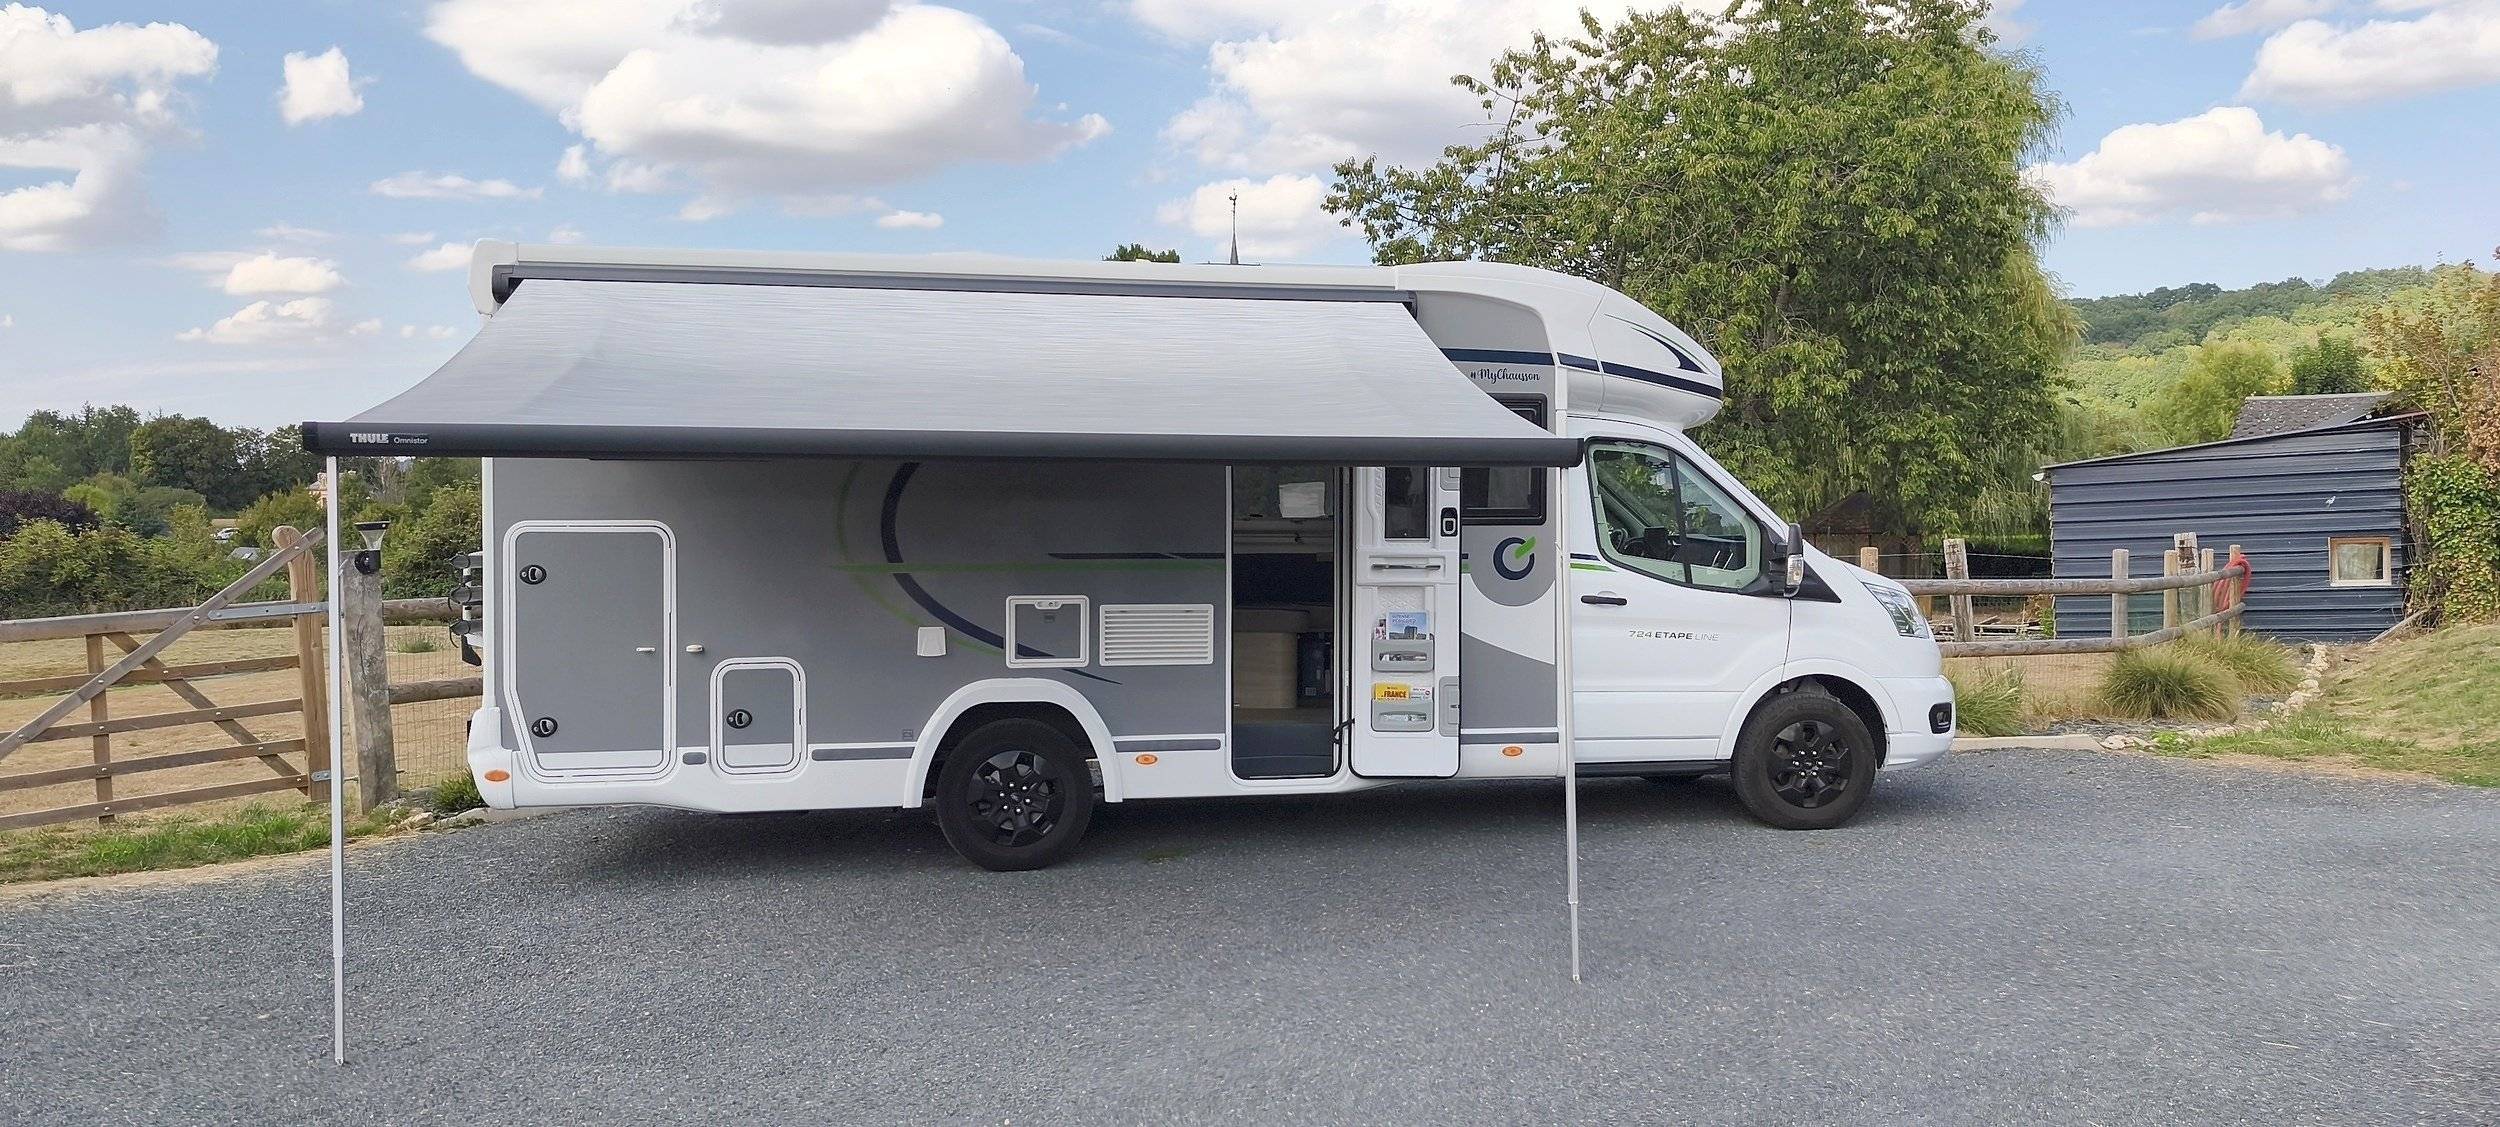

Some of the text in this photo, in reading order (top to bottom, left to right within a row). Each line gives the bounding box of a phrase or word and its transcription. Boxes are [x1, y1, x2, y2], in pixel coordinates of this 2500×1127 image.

[349, 433, 389, 443] THULE
[1654, 632, 1693, 640] ETAPE
[1694, 633, 1719, 641] LINE
[1383, 690, 1407, 698] FRANCE
